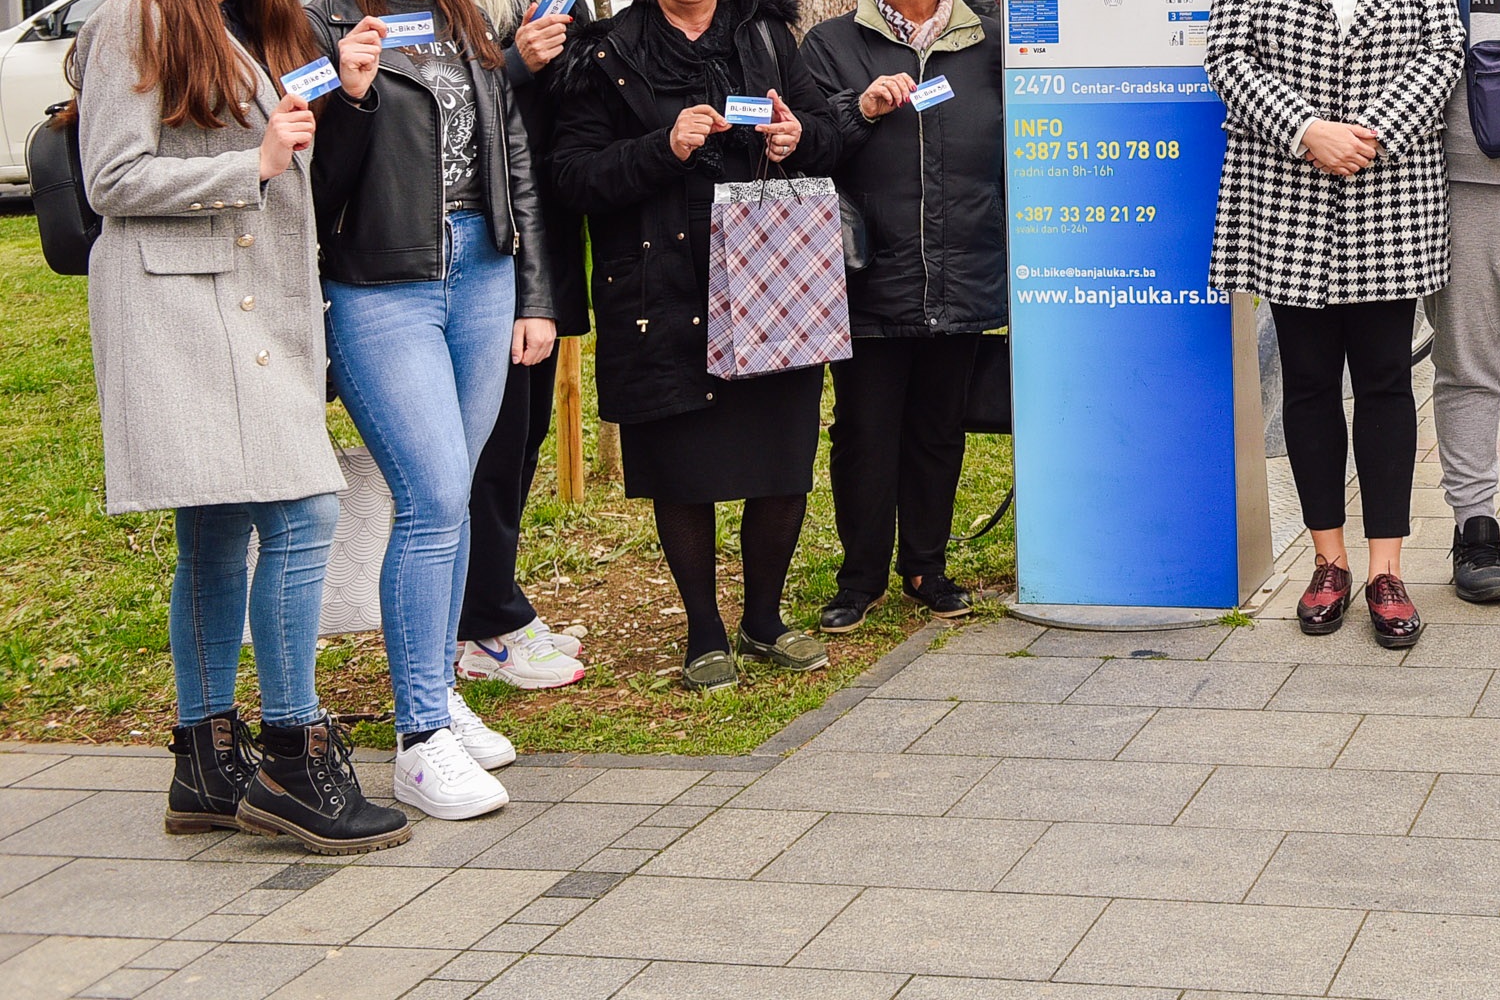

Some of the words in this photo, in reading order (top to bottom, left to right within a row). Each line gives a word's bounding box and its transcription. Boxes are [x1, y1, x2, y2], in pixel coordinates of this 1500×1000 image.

[1171, 12, 1176, 21] 3
[291, 75, 320, 92] BL-Bike
[1014, 74, 1065, 95] 2470
[1072, 81, 1174, 95] Centar-Gradska
[1178, 82, 1216, 95] uprav
[913, 88, 937, 101] BL-Bike
[730, 105, 757, 113] BL-Bike
[1014, 118, 1063, 137] INFO
[1014, 142, 1061, 160] +387
[1067, 141, 1089, 160] 51
[1096, 141, 1121, 160] 30
[1126, 140, 1150, 160] 78
[1155, 140, 1180, 160] 08
[1014, 166, 1044, 177] radni
[1047, 166, 1069, 177] dan
[1072, 165, 1115, 177] 8h-16h
[1016, 207, 1053, 222] +387
[1059, 206, 1080, 222] 33
[1085, 206, 1106, 222] 28
[1110, 206, 1129, 222] 21
[1135, 206, 1157, 222] 29
[1041, 223, 1059, 234] dan
[1061, 223, 1088, 234] 0-24h
[1031, 267, 1156, 280] bl.bike@banjaluka.rs.ba
[1017, 286, 1230, 309] www.banjaluka.rs.ba
